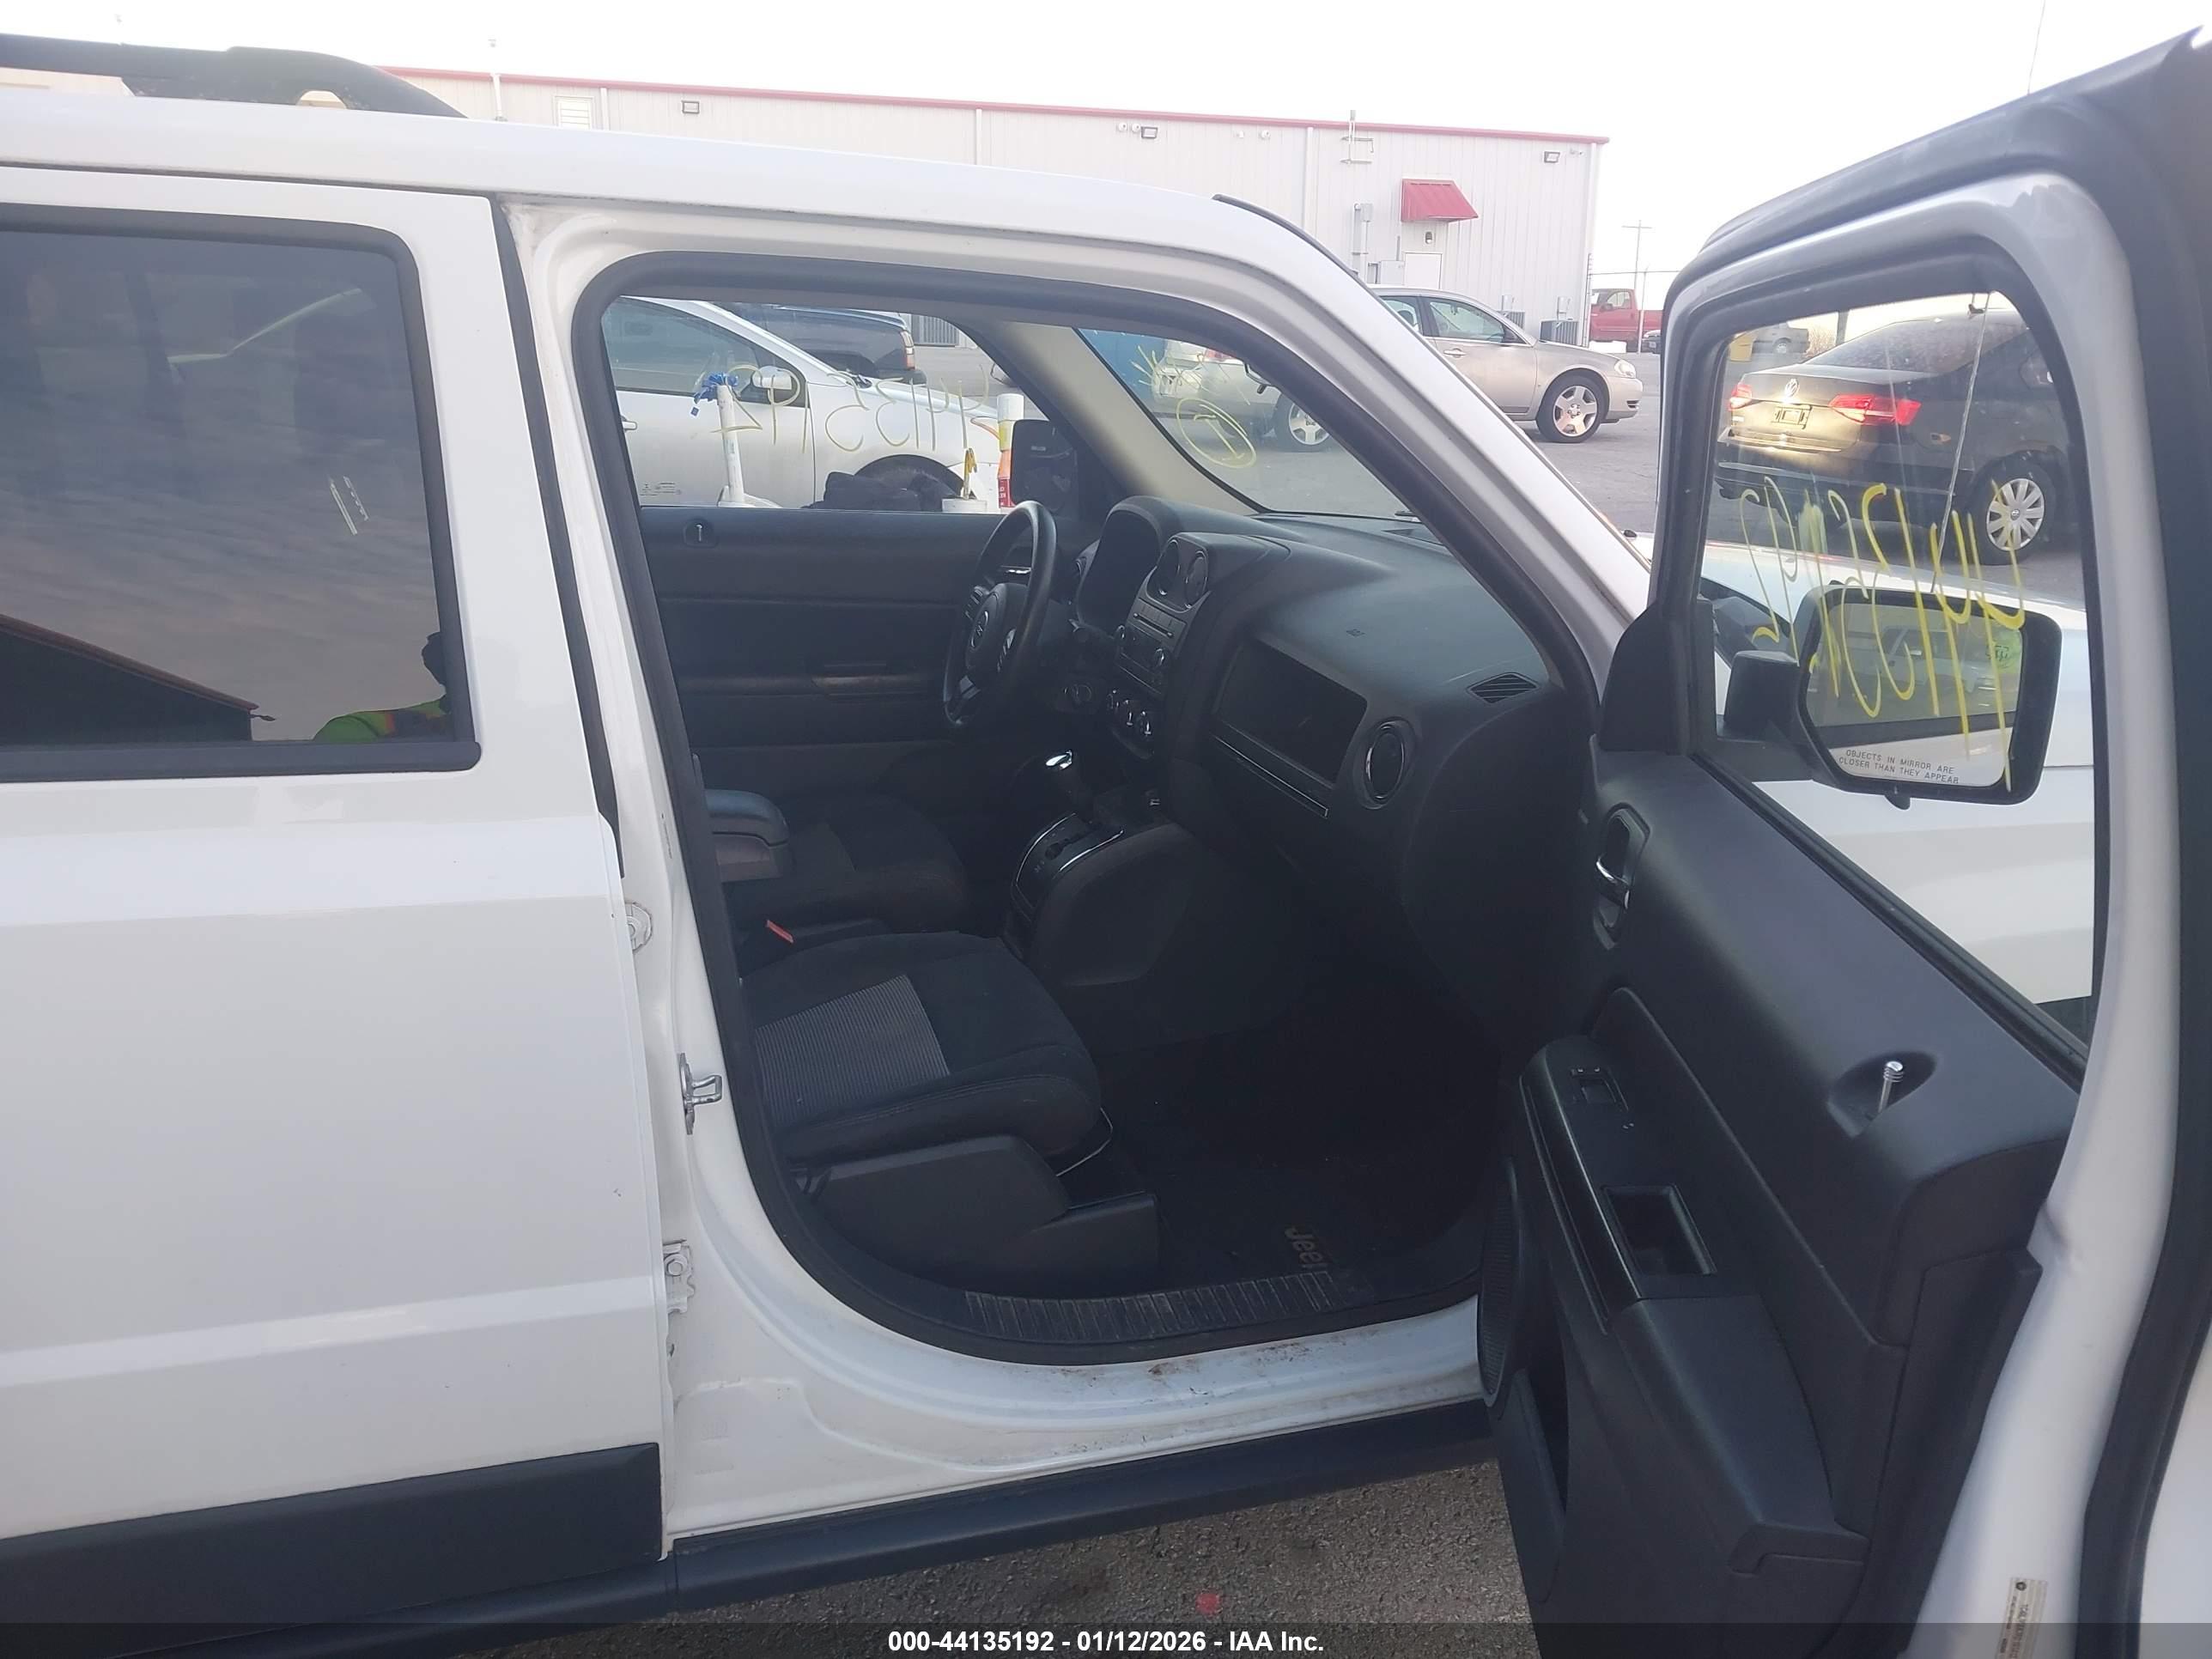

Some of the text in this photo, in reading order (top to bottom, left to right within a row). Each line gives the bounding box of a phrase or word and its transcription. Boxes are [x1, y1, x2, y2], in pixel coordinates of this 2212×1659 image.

[1838, 756, 1960, 785] CLOSER THAN THEY APPEAR
[1845, 749, 1955, 775] OBJECTS IN MIRROR ARE
